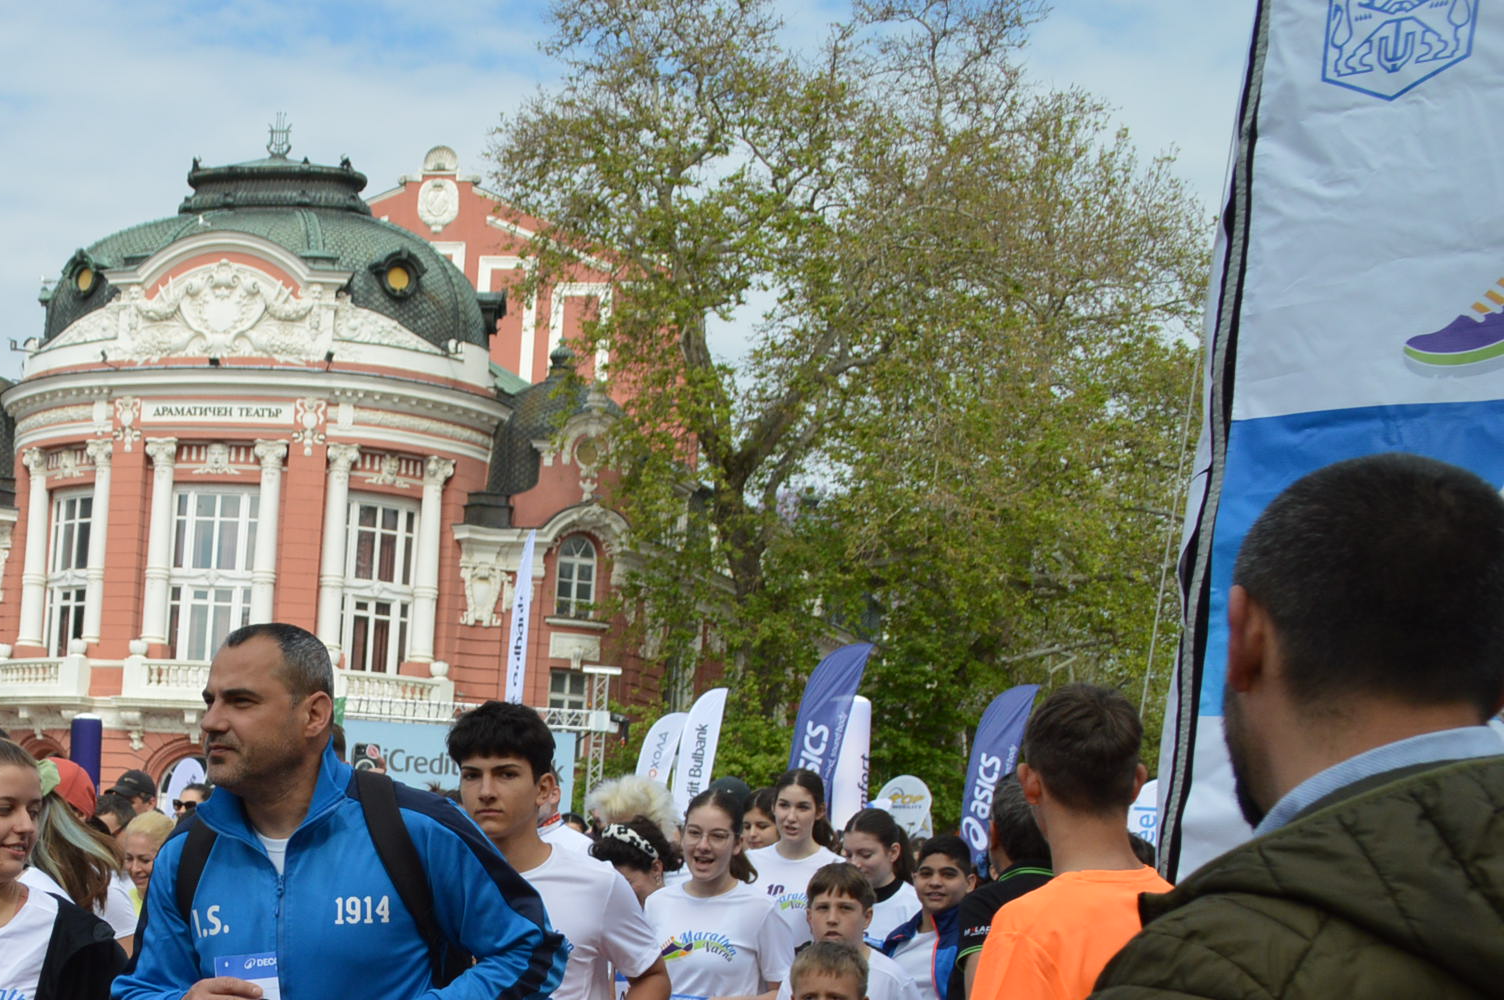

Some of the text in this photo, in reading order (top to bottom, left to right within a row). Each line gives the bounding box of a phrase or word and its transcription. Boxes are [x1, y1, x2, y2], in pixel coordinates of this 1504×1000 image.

[153, 406, 283, 418] ДРАМАТИЧЕН ТЕАТЪР
[649, 731, 669, 778] ОХОЛД
[688, 723, 710, 778] Bulbank
[334, 895, 391, 925] 1914
[679, 930, 737, 956] Marathon
